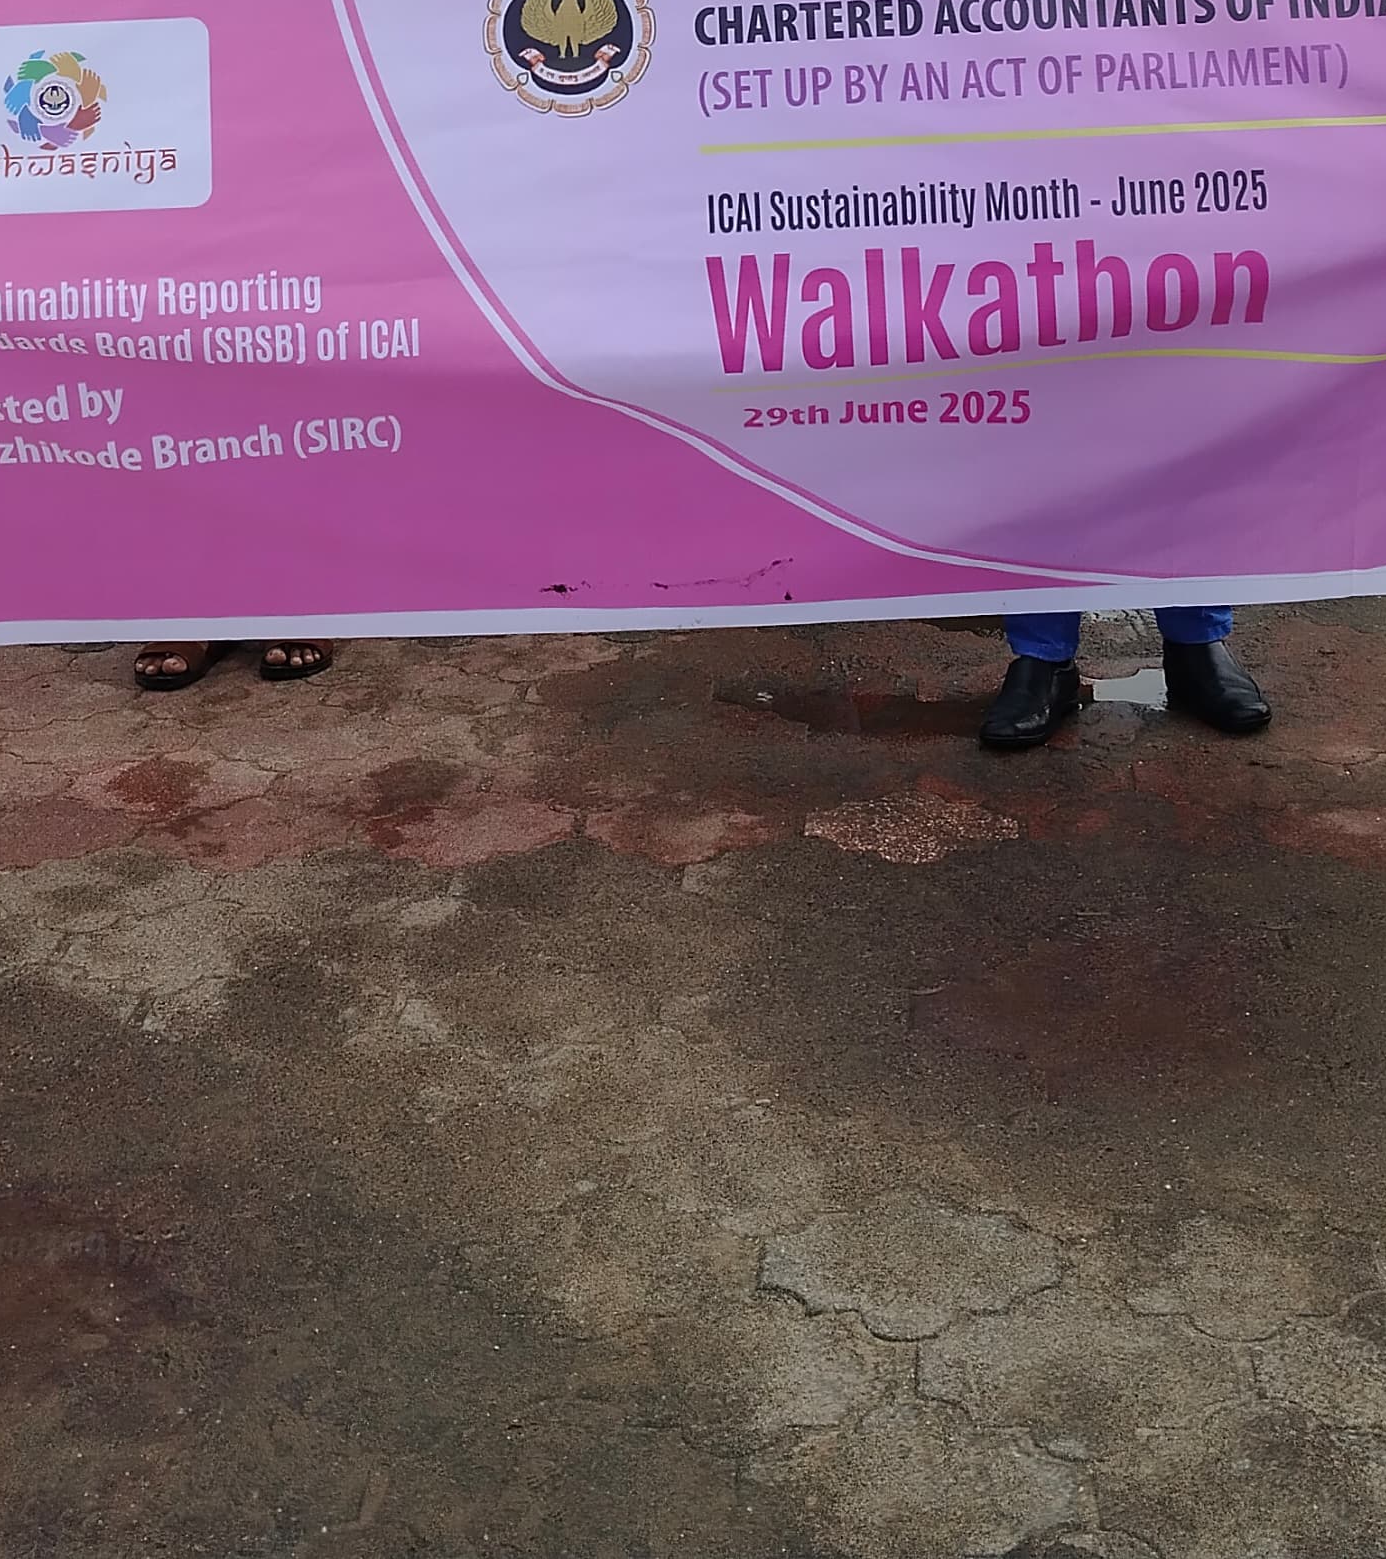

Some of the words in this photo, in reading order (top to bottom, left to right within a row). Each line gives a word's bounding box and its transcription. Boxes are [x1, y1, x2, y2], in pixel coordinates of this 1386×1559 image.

[699, 69, 773, 118] (SET
[784, 65, 832, 107] UP
[844, 63, 889, 105] BY
[900, 61, 949, 102] AN
[961, 57, 1027, 99] ACT
[1038, 54, 1083, 95] OF
[1095, 42, 1349, 93] PARLIAMENT)
[707, 191, 762, 234] ICAI
[770, 181, 976, 231] Sustainability
[984, 178, 1080, 222] Month
[1112, 176, 1185, 216] June
[1195, 169, 1268, 213] 2025
[157, 270, 322, 320] Reporting
[705, 239, 1269, 374] Walkathon
[95, 328, 193, 362] Board
[203, 322, 306, 365] (SRSB)
[316, 321, 350, 361] of
[359, 318, 420, 360] ICAI
[77, 382, 124, 425] by
[742, 404, 830, 428] 29th
[839, 399, 929, 425] June
[938, 390, 1031, 425] 2025
[151, 424, 284, 470] Branch
[293, 415, 402, 458] (SIRC)
